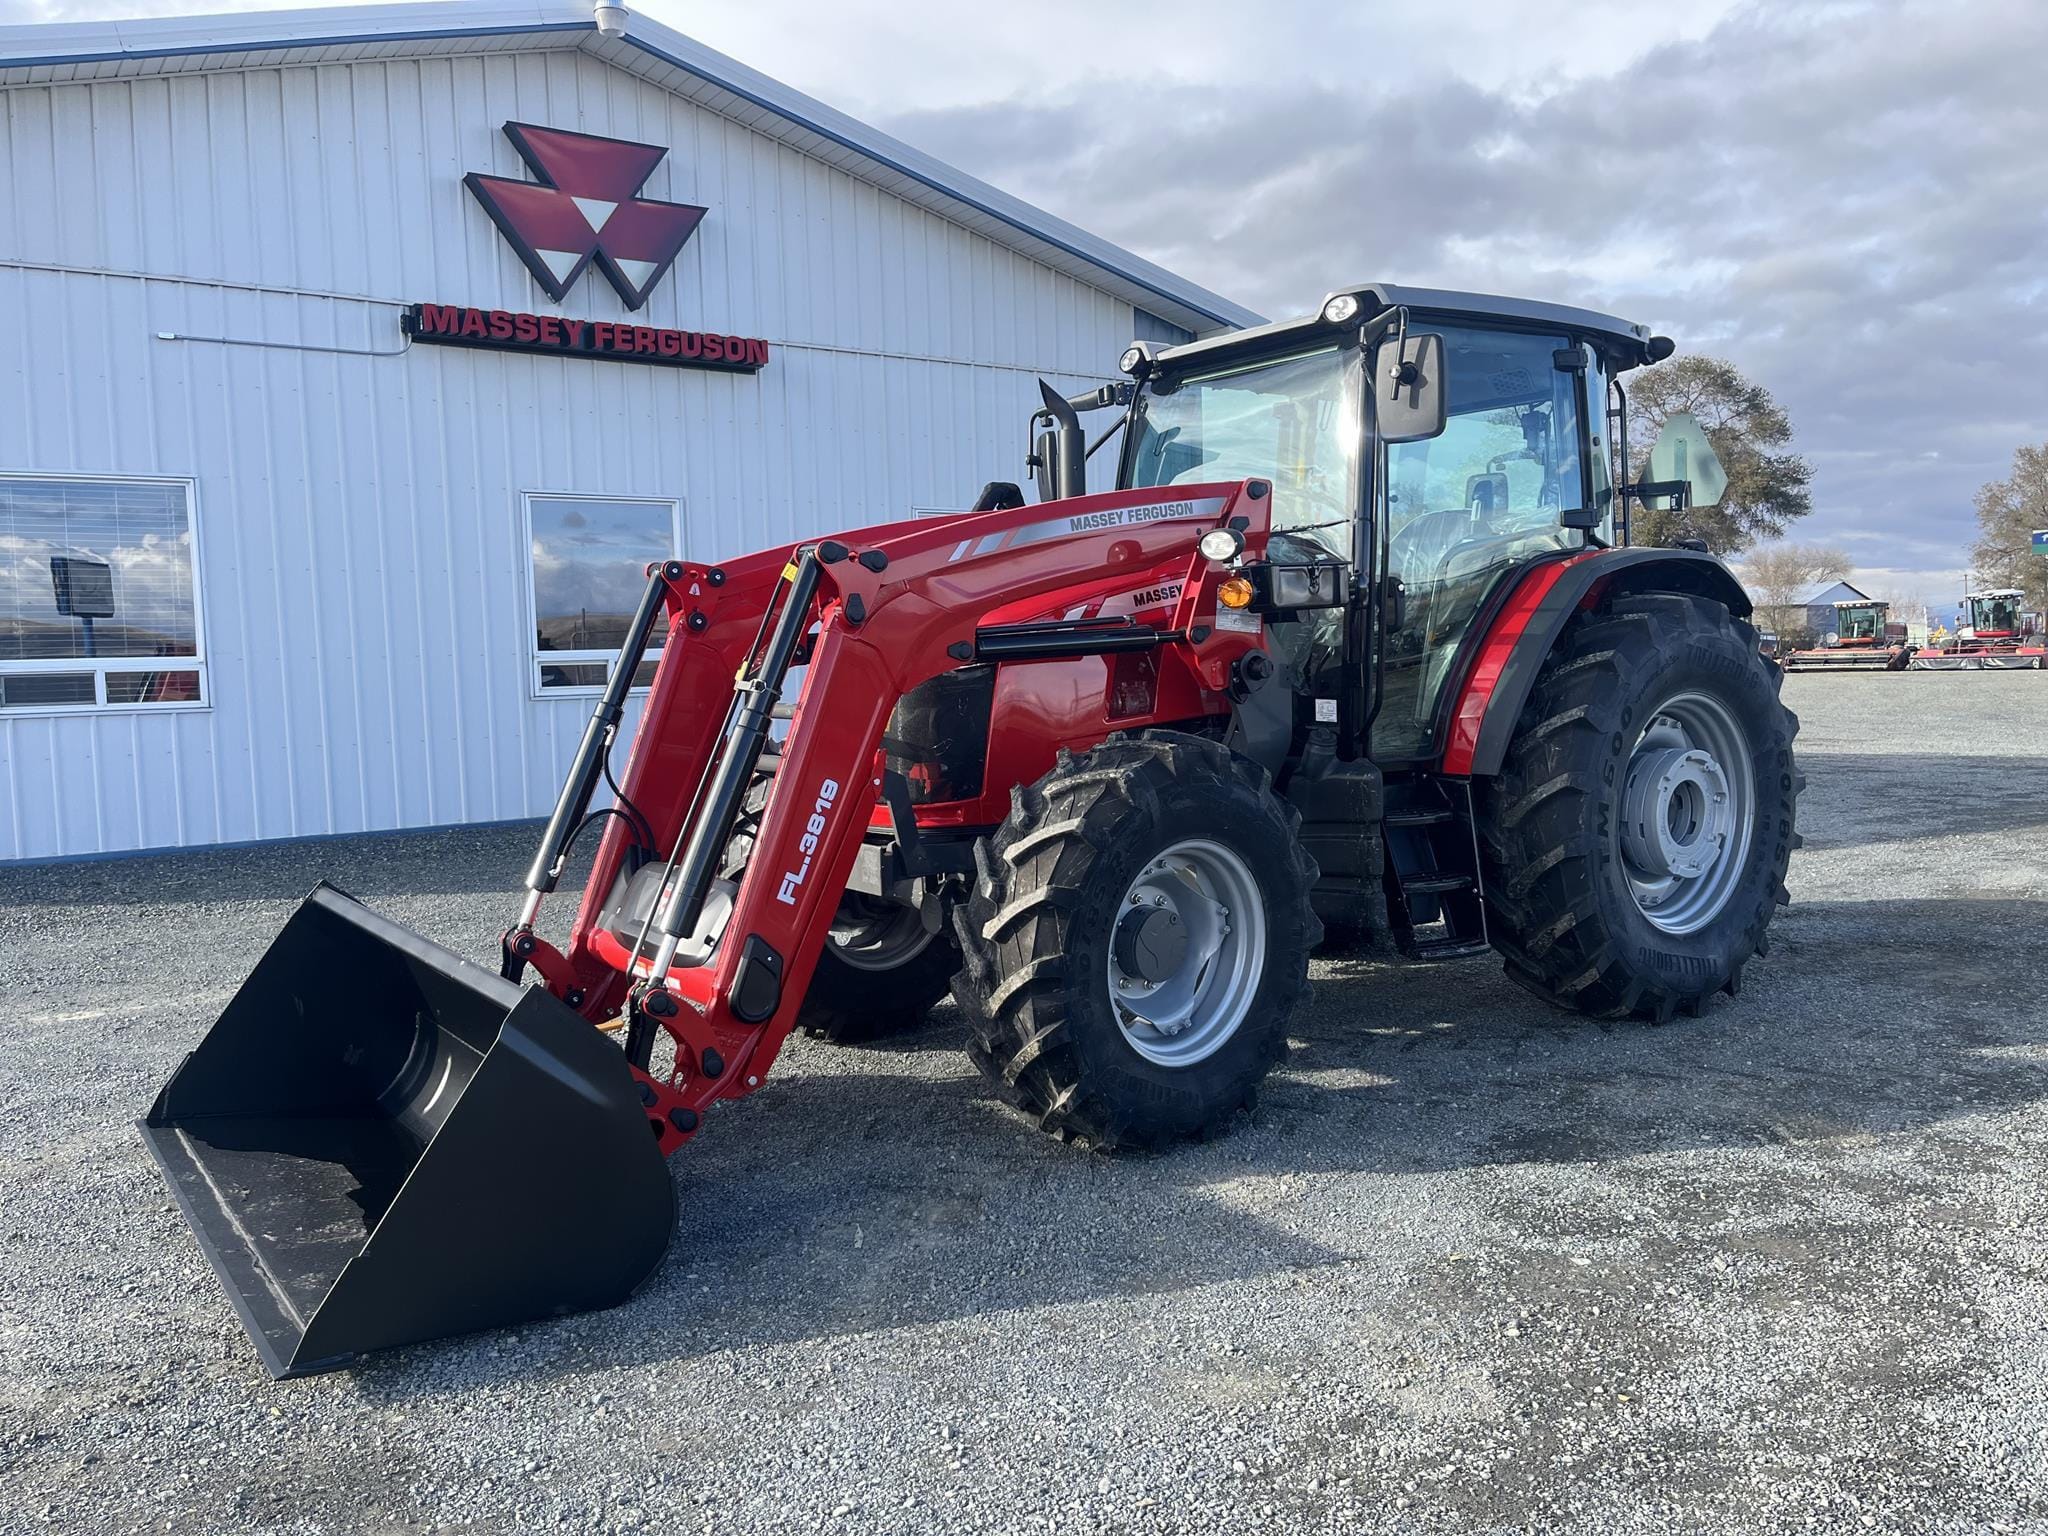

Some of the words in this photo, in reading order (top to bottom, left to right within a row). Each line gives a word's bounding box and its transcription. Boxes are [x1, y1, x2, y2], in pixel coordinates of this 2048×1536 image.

[423, 303, 585, 348] MASSEY
[593, 322, 769, 365] FERGUSON
[1070, 512, 1124, 532] MASSEY
[1128, 501, 1194, 523] FERGUSON
[1133, 584, 1183, 607] MASSEY
[776, 779, 839, 906] FL.3819
